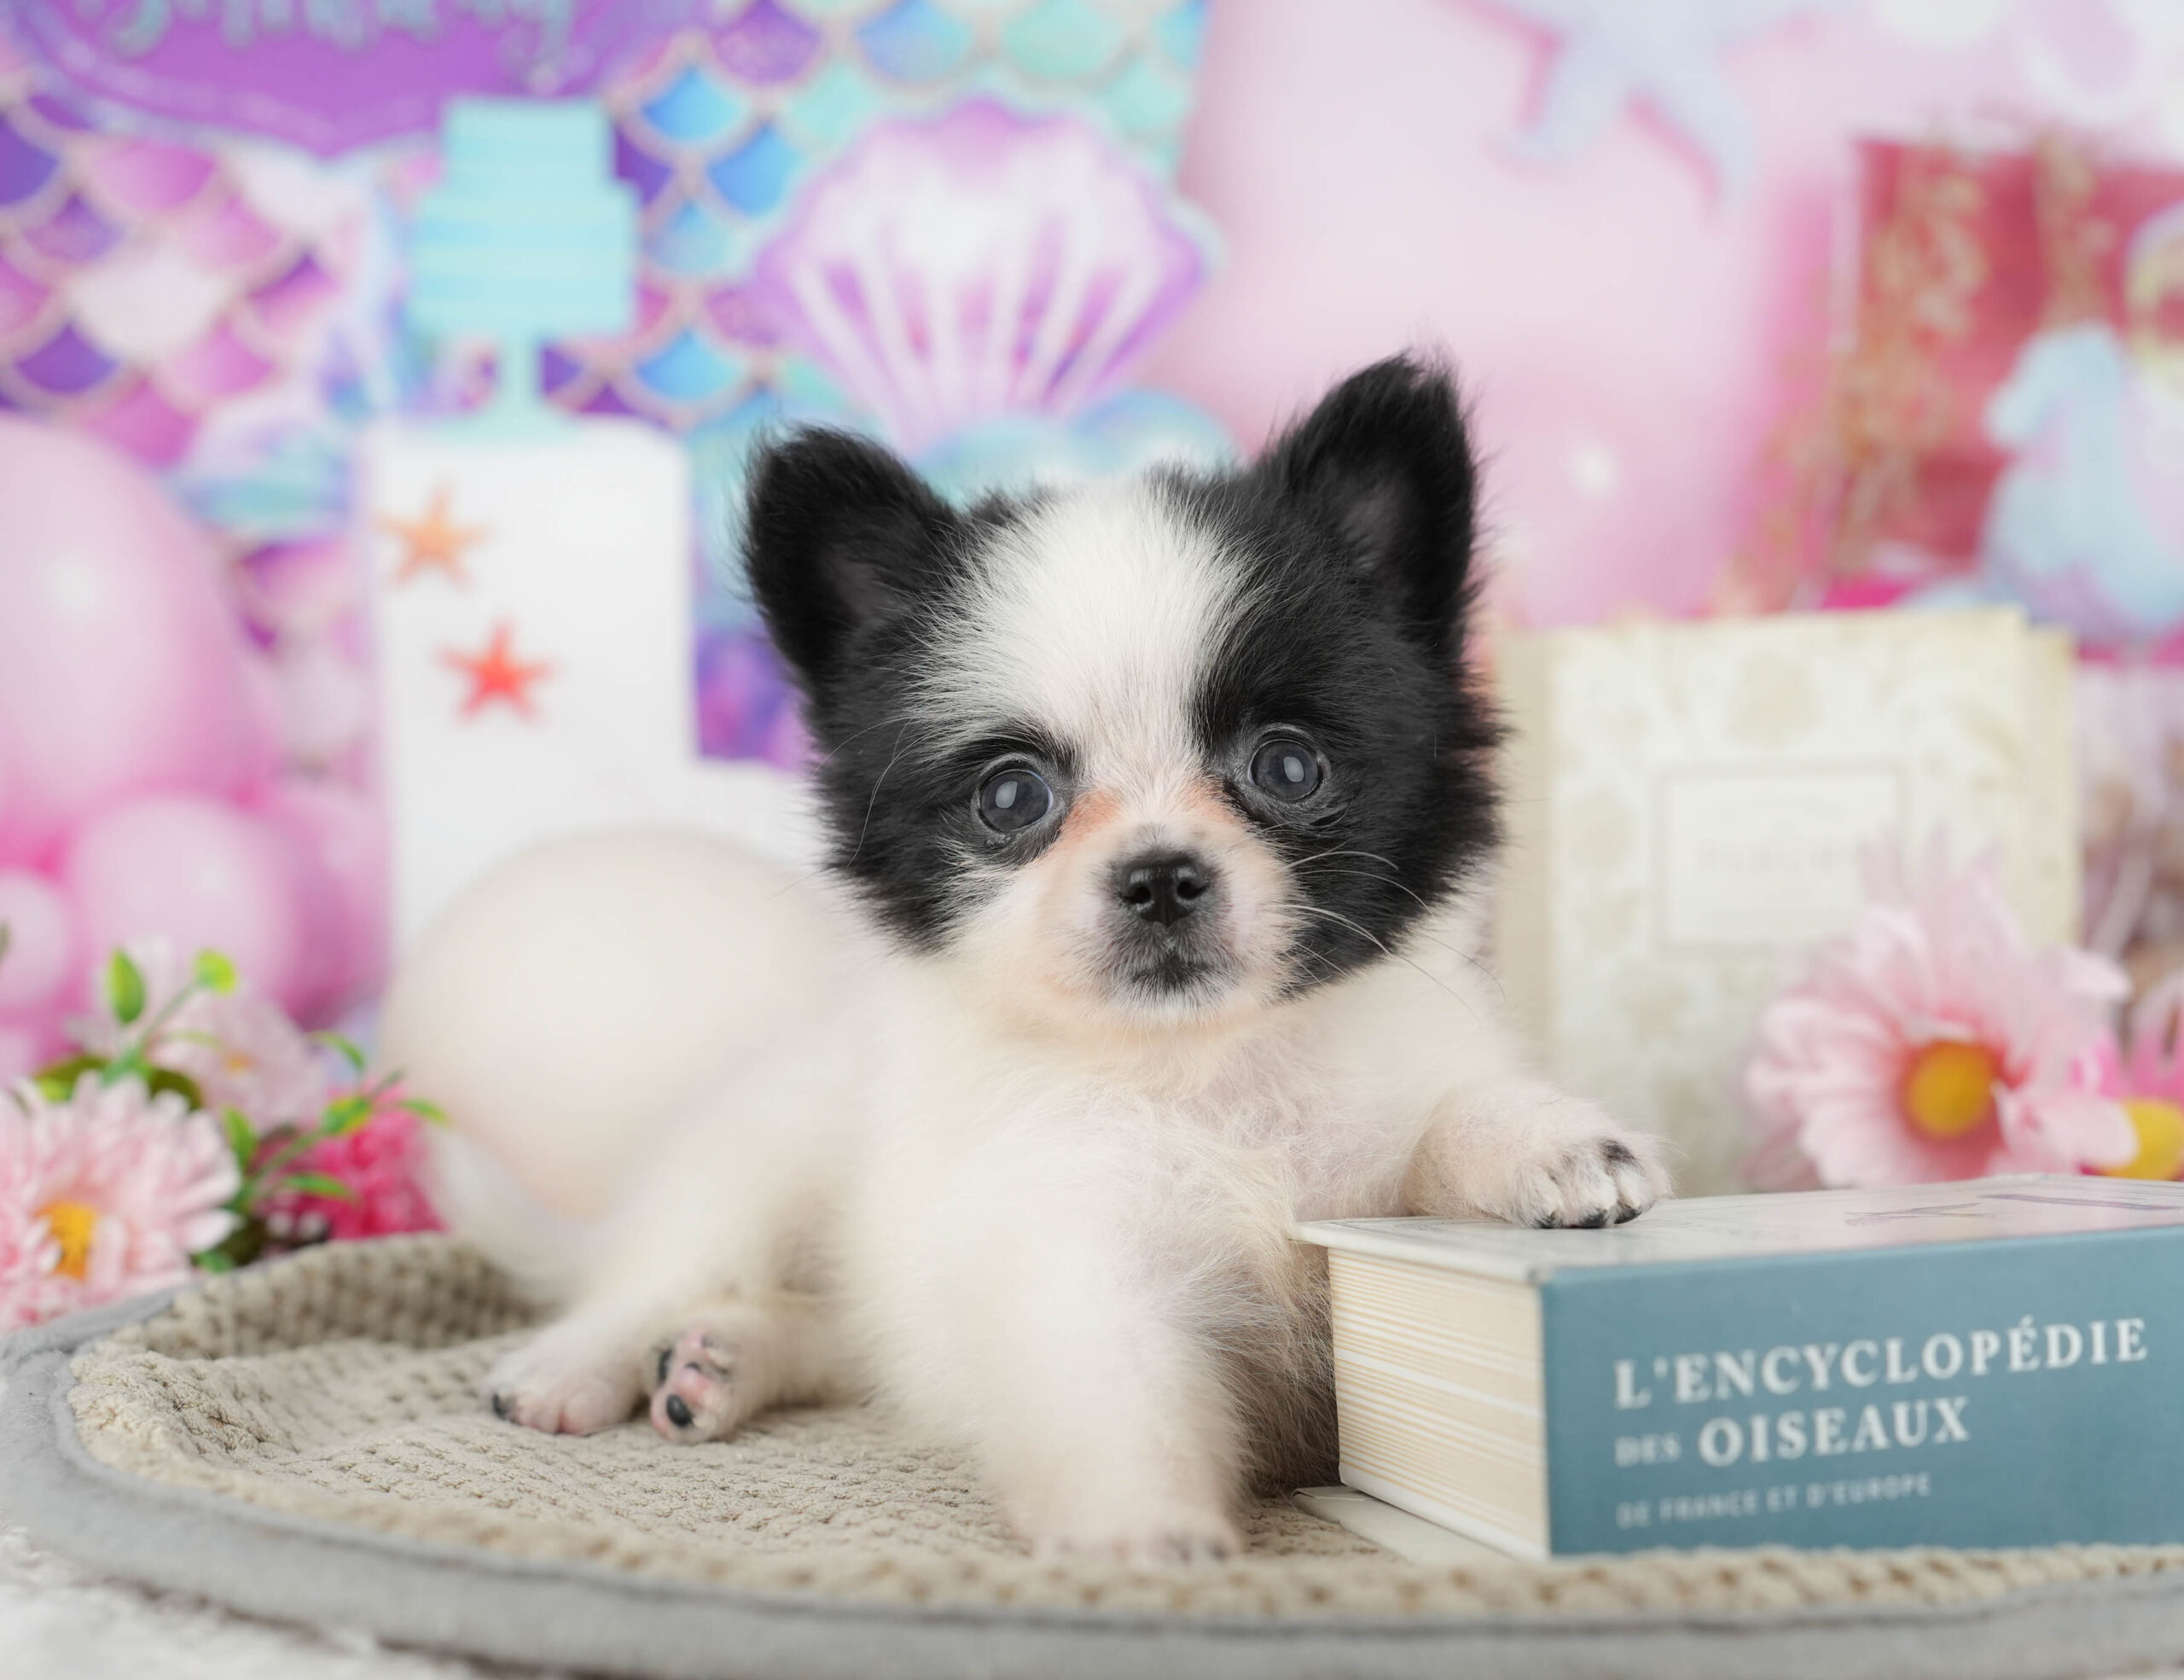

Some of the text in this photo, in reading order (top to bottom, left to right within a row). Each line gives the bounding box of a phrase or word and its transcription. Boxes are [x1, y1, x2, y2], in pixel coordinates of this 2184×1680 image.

[1614, 1315, 2148, 1409] L'ENCYCLOPÉDIE
[1615, 1397, 1970, 1468] DES OISEAUX
[1617, 1472, 1930, 1530] DE FRANCE ET D'EUROPE
